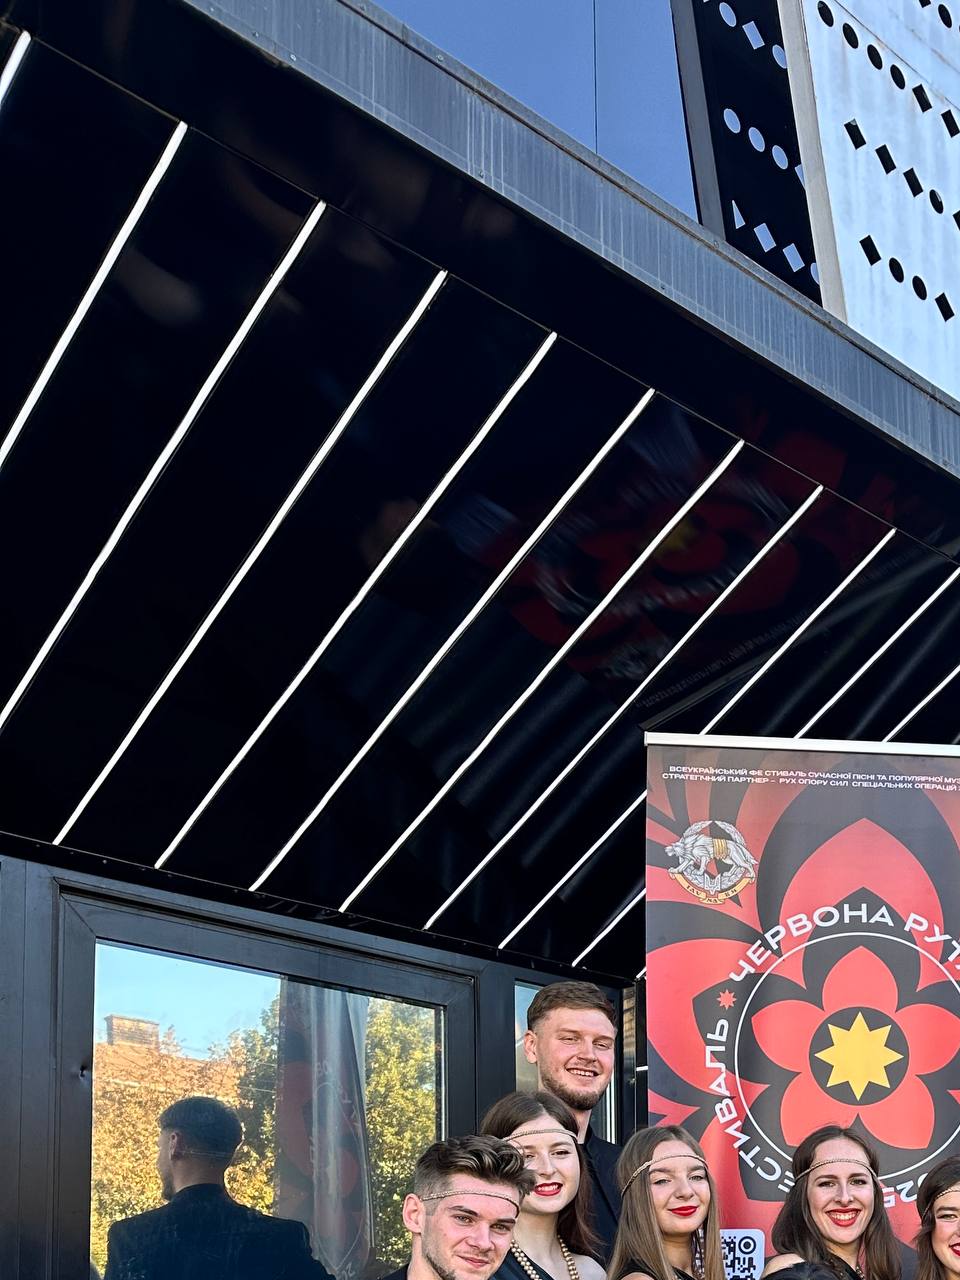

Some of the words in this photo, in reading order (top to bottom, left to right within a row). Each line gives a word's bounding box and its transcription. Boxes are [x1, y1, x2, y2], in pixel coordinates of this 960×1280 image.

[669, 766, 747, 775] ВСЕУКРАЇНСЬКИЙ
[808, 771, 851, 779] СУЧАСНОЇ
[889, 775, 943, 783] ПОПУЛЯРНОЇ
[728, 776, 769, 784] ПАРТНЕР
[852, 781, 912, 789] СПЕЦІАЛЬНИХ
[914, 782, 957, 791] ОПЕРАЦІЙ
[729, 903, 895, 983] ЧЕРВОНА
[705, 1018, 796, 1193] ЕСТИВАЛЬ
